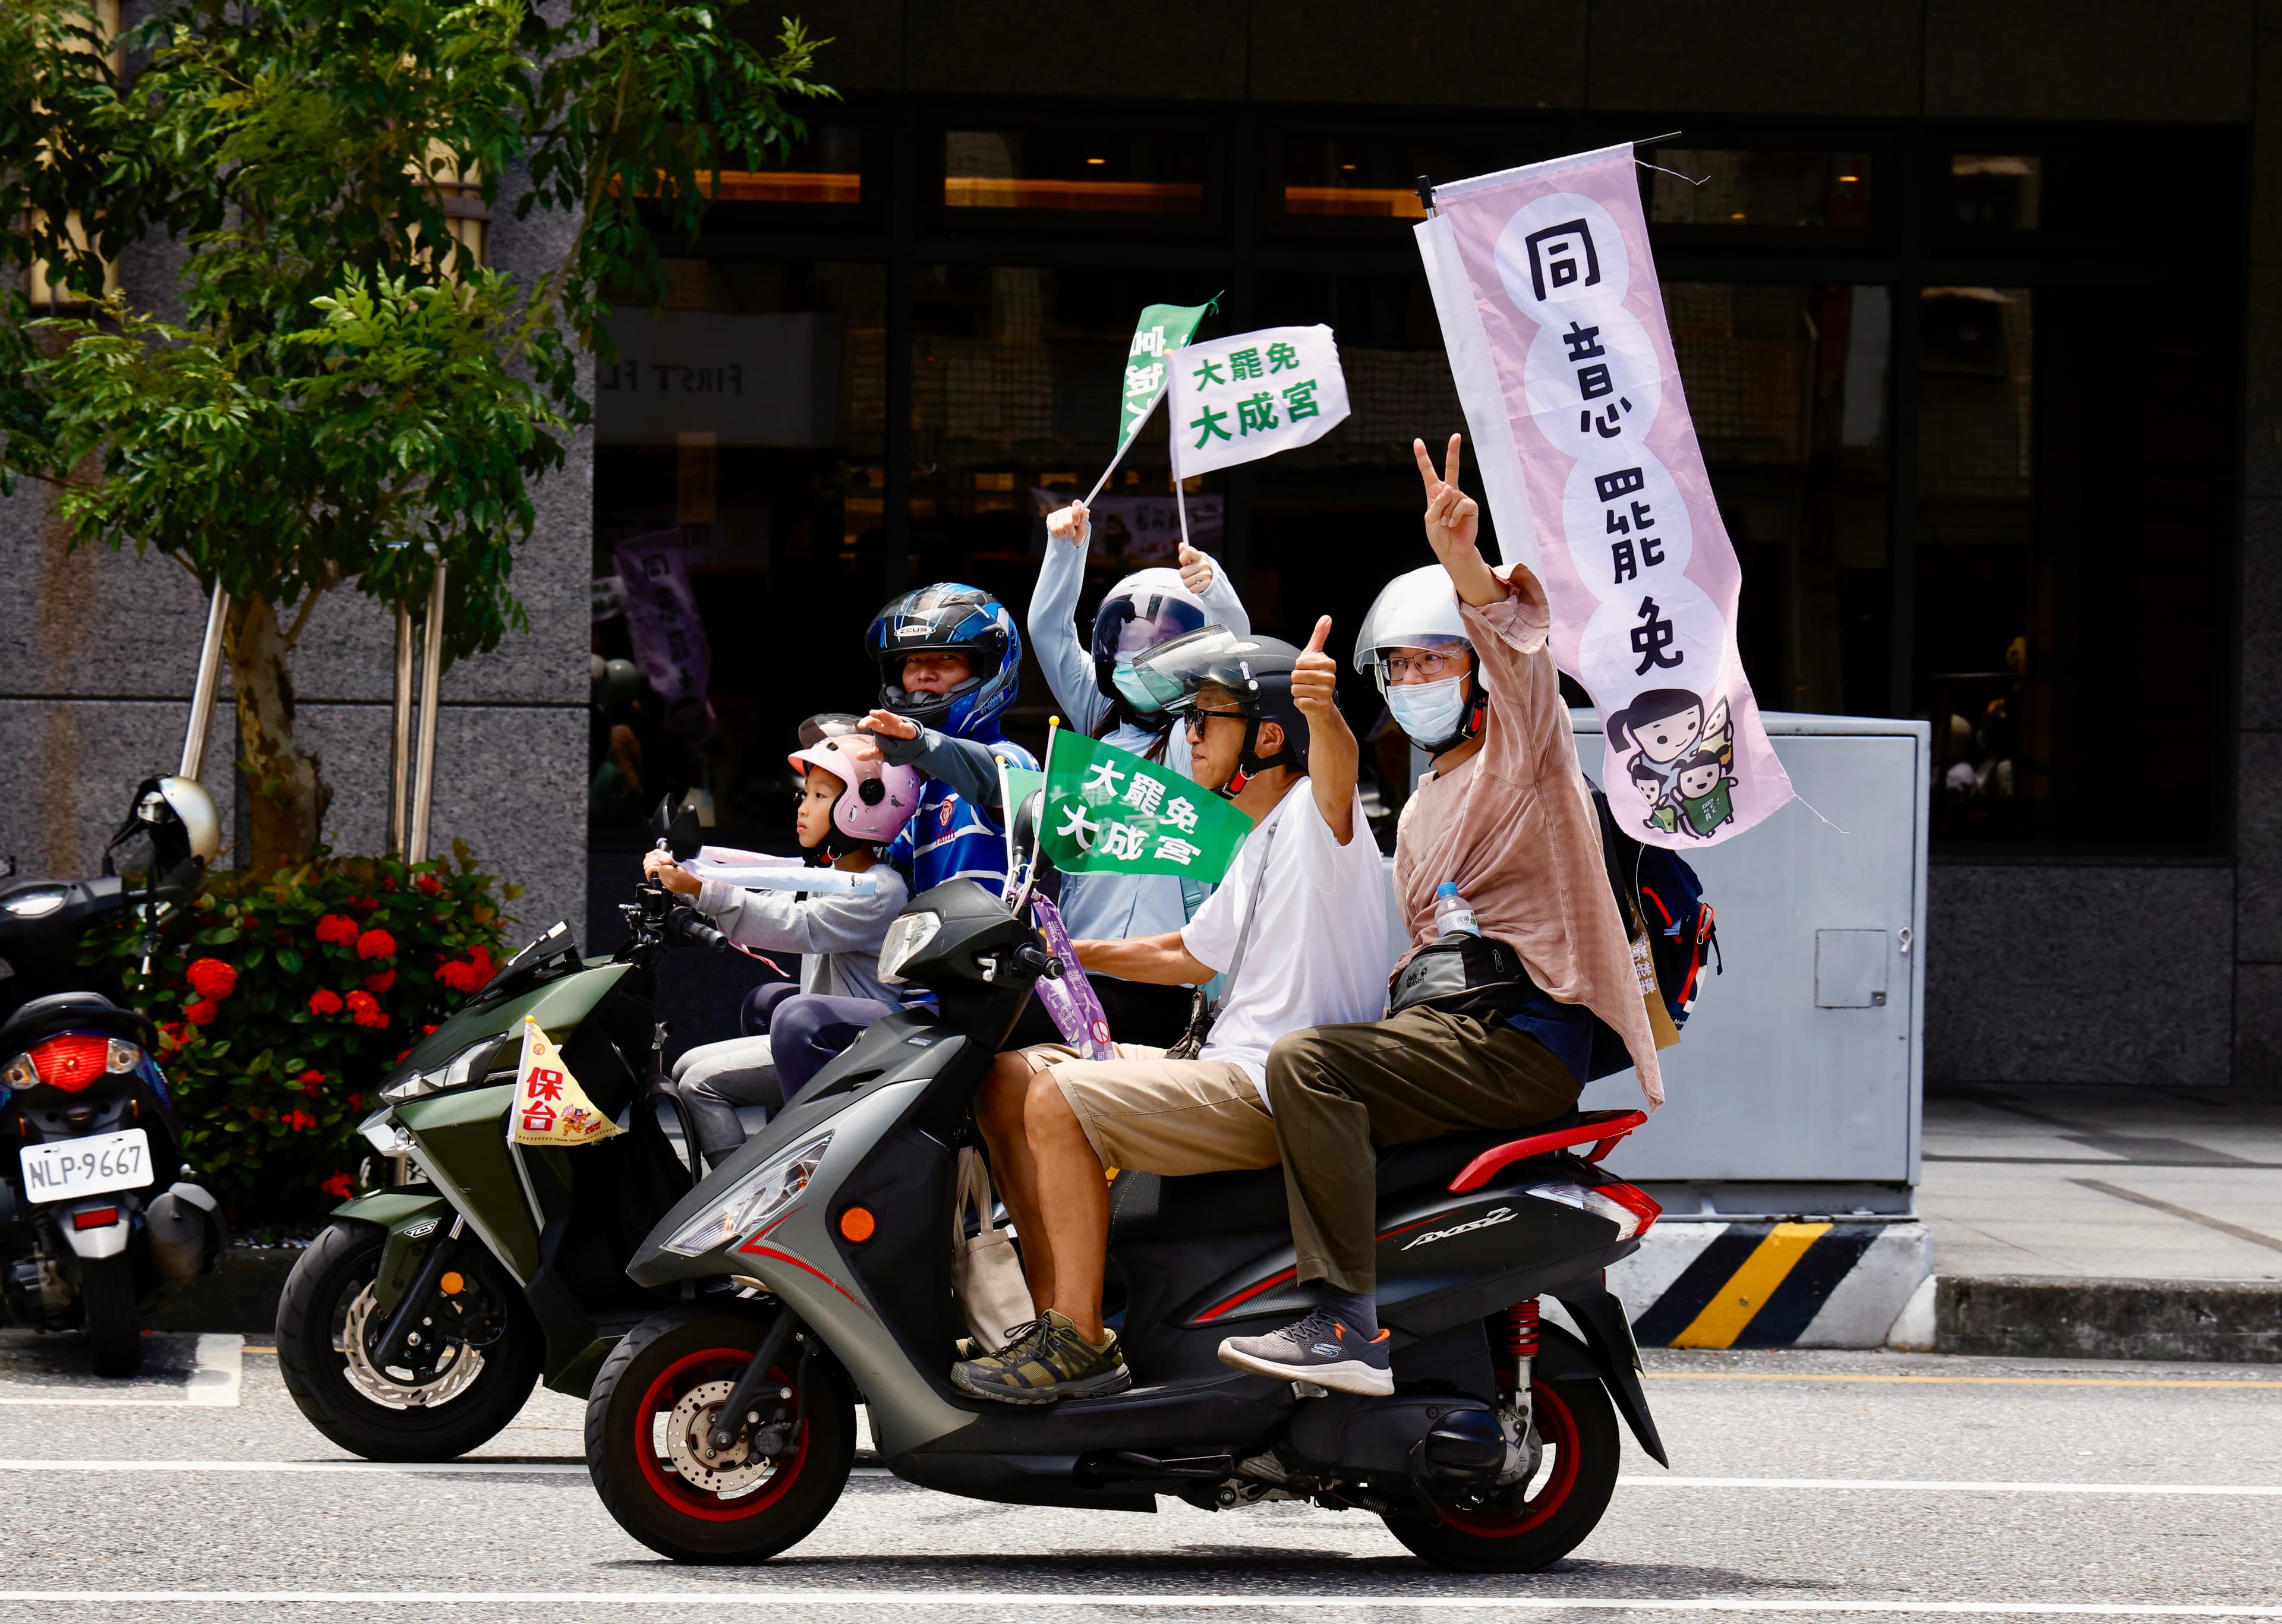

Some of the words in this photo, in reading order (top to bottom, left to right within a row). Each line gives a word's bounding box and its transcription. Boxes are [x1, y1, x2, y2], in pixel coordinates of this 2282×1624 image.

[1193, 342, 1301, 392] 大罷免
[1190, 379, 1321, 449] 大成宮
[1525, 218, 1684, 676] 同意罷免
[1085, 759, 1199, 835] 大罷免
[1057, 804, 1202, 866] 大成宮
[522, 1067, 564, 1132] 保台
